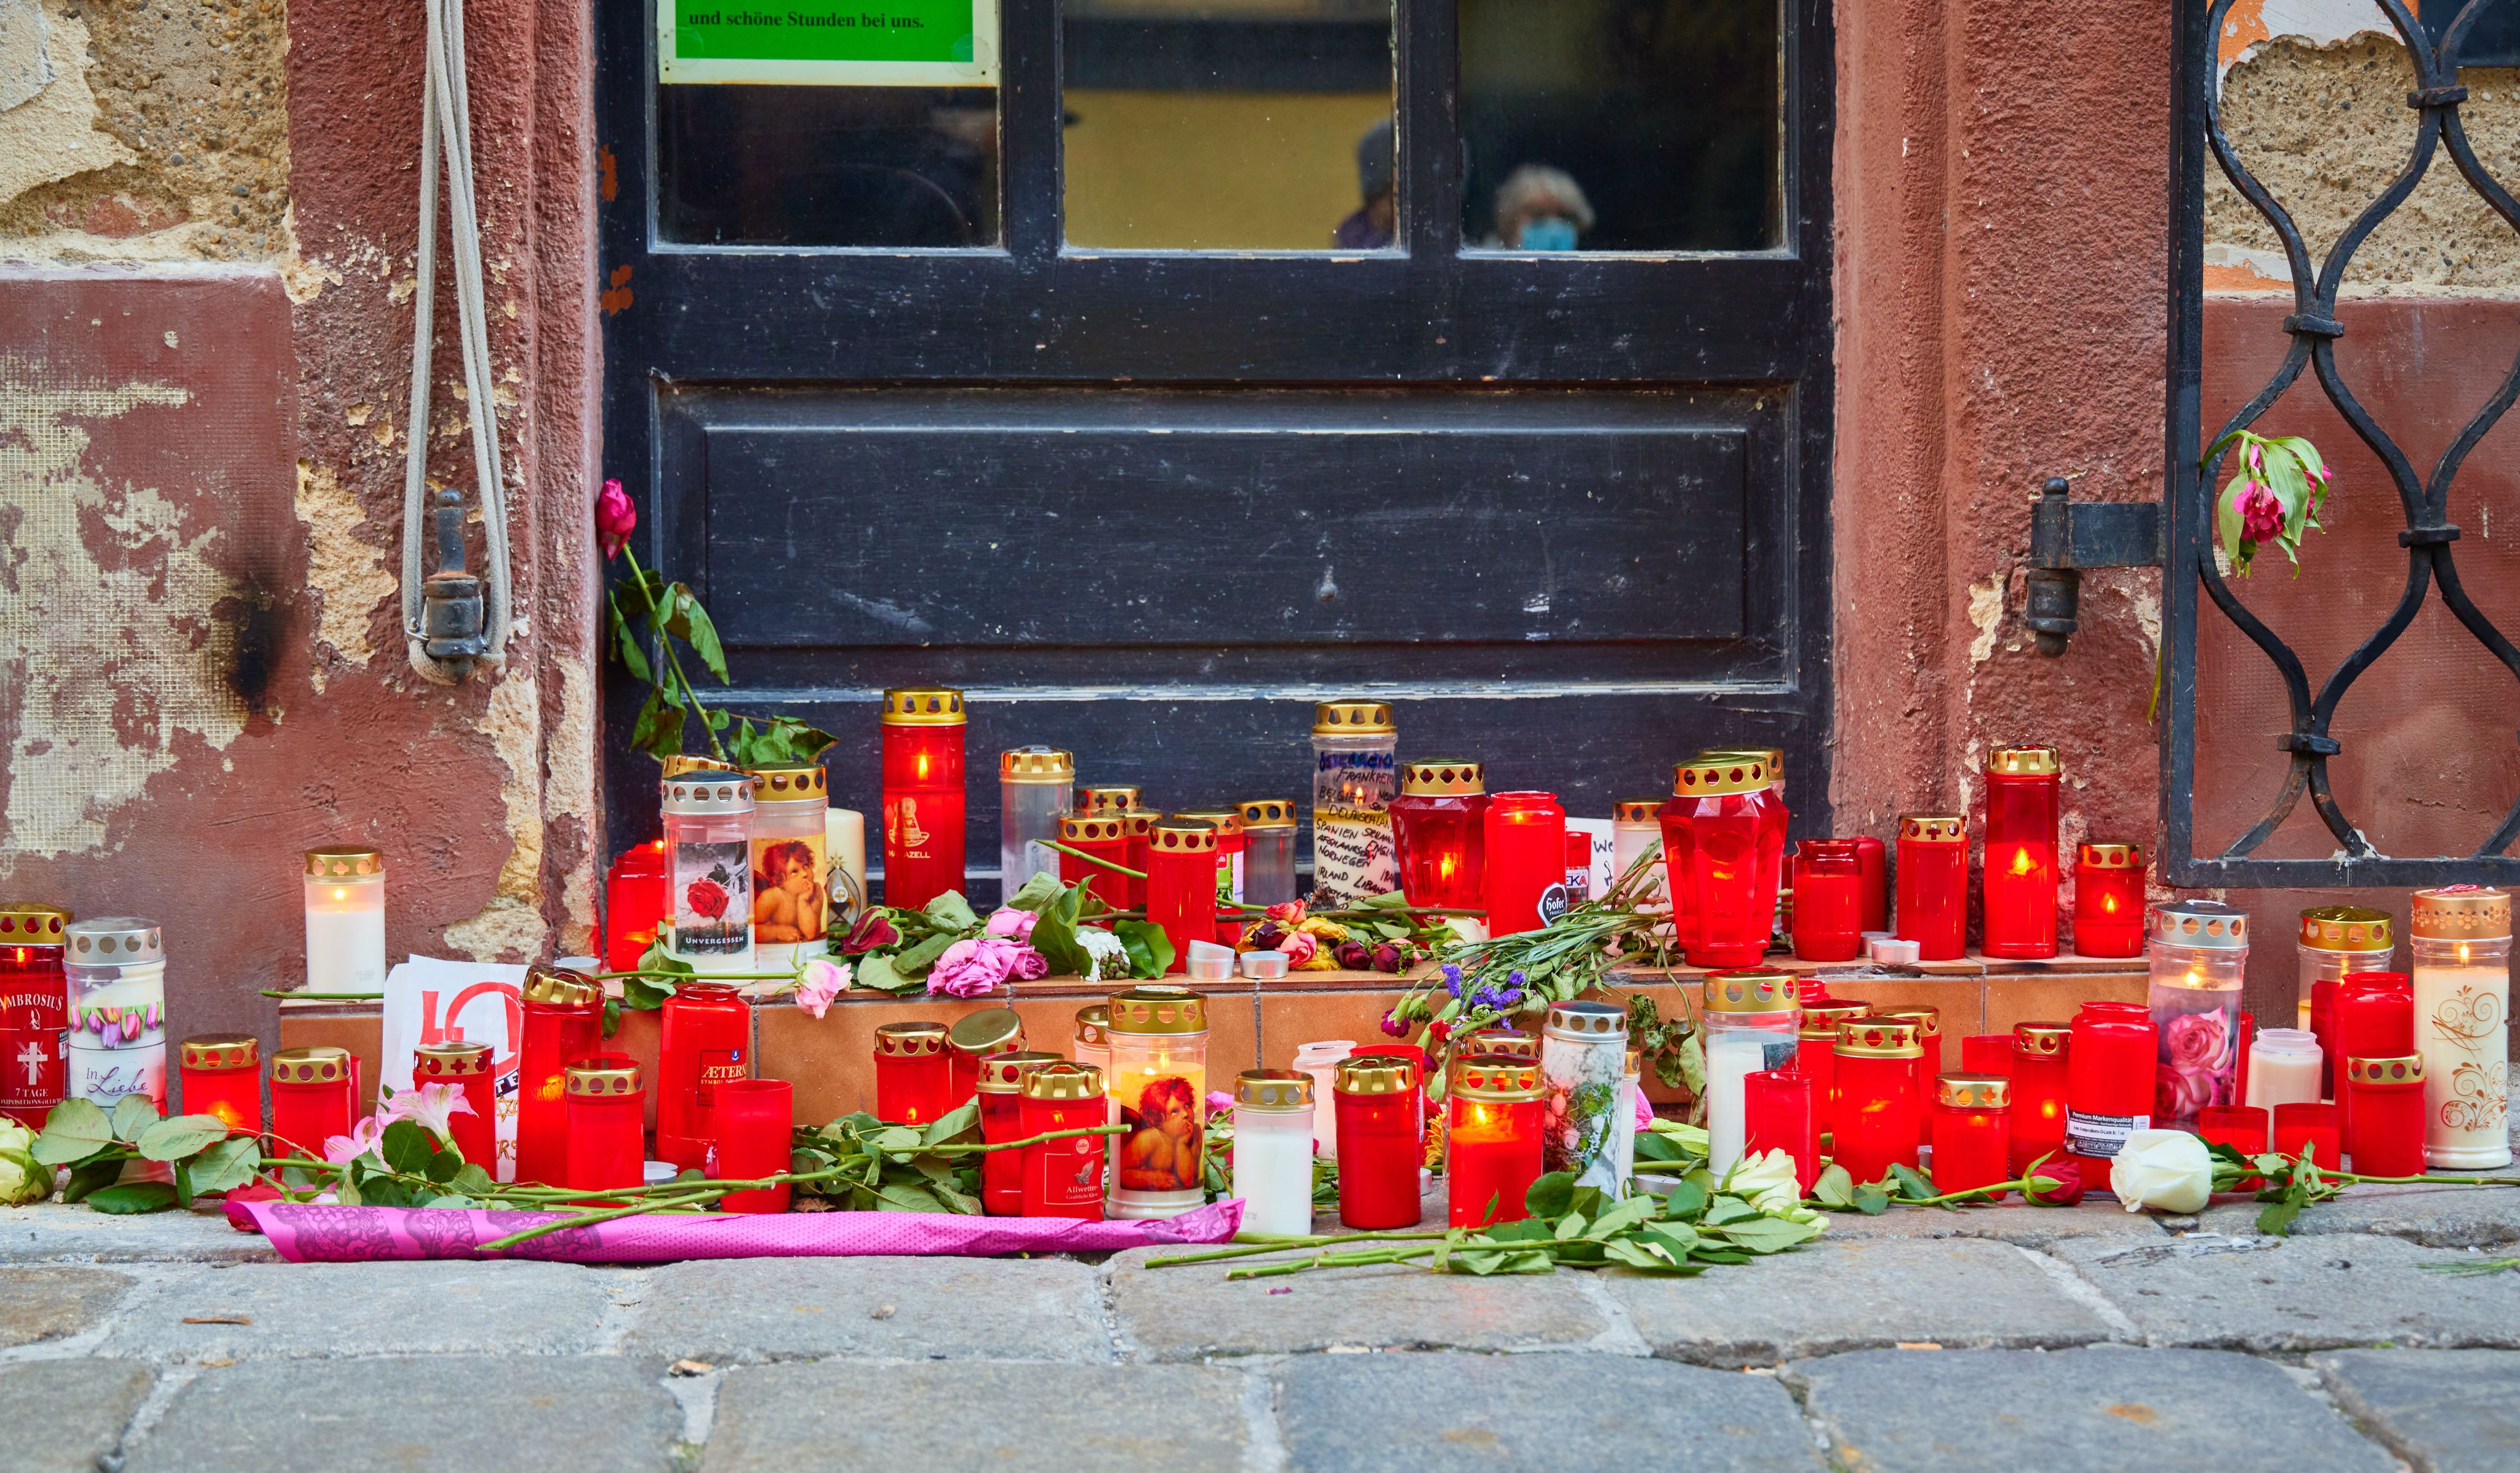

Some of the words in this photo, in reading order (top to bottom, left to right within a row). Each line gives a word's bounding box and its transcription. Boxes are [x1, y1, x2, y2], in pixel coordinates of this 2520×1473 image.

[689, 11, 721, 25] und
[726, 12, 783, 26] schöne
[788, 12, 856, 27] Stunden
[861, 13, 886, 27] bei
[891, 16, 925, 28] uns.
[1316, 818, 1359, 839] SPANIEN
[1318, 844, 1372, 868] NORWEGEN
[1317, 866, 1349, 881] IRLAND
[0, 993, 63, 1011] AMBROSIUS
[86, 1067, 98, 1080] In
[87, 1067, 148, 1096] Liebe
[15, 1087, 20, 1096] 7
[22, 1088, 49, 1098] TAGE
[2072, 1111, 2092, 1120] Premium
[2092, 1115, 2133, 1123] Markenqualität
